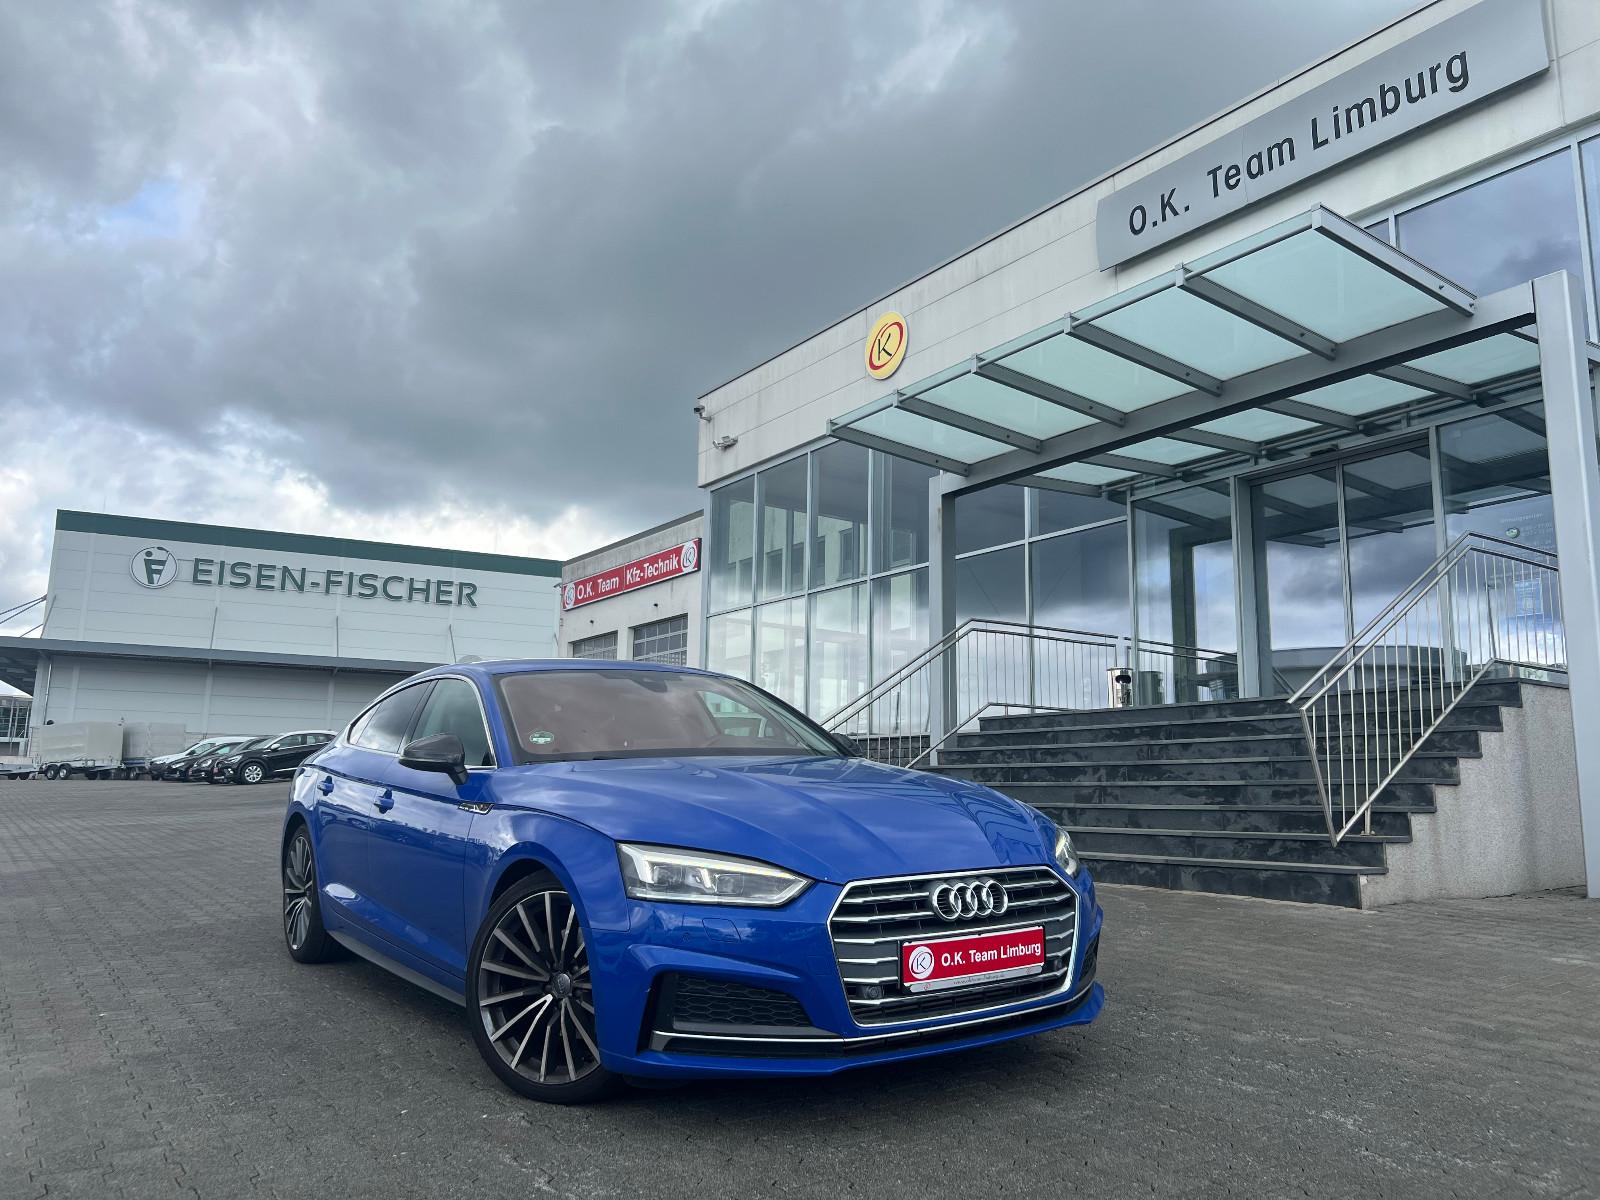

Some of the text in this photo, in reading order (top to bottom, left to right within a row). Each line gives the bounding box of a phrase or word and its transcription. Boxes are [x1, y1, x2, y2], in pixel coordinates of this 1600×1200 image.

[1128, 50, 1470, 236] O.K. Team Limburg
[192, 557, 479, 608] EISEN-FISCHER
[626, 553, 679, 585] Kfz-Technik
[576, 576, 619, 600] O.K. Team
[941, 942, 1041, 967] O.K. Team Limburg
